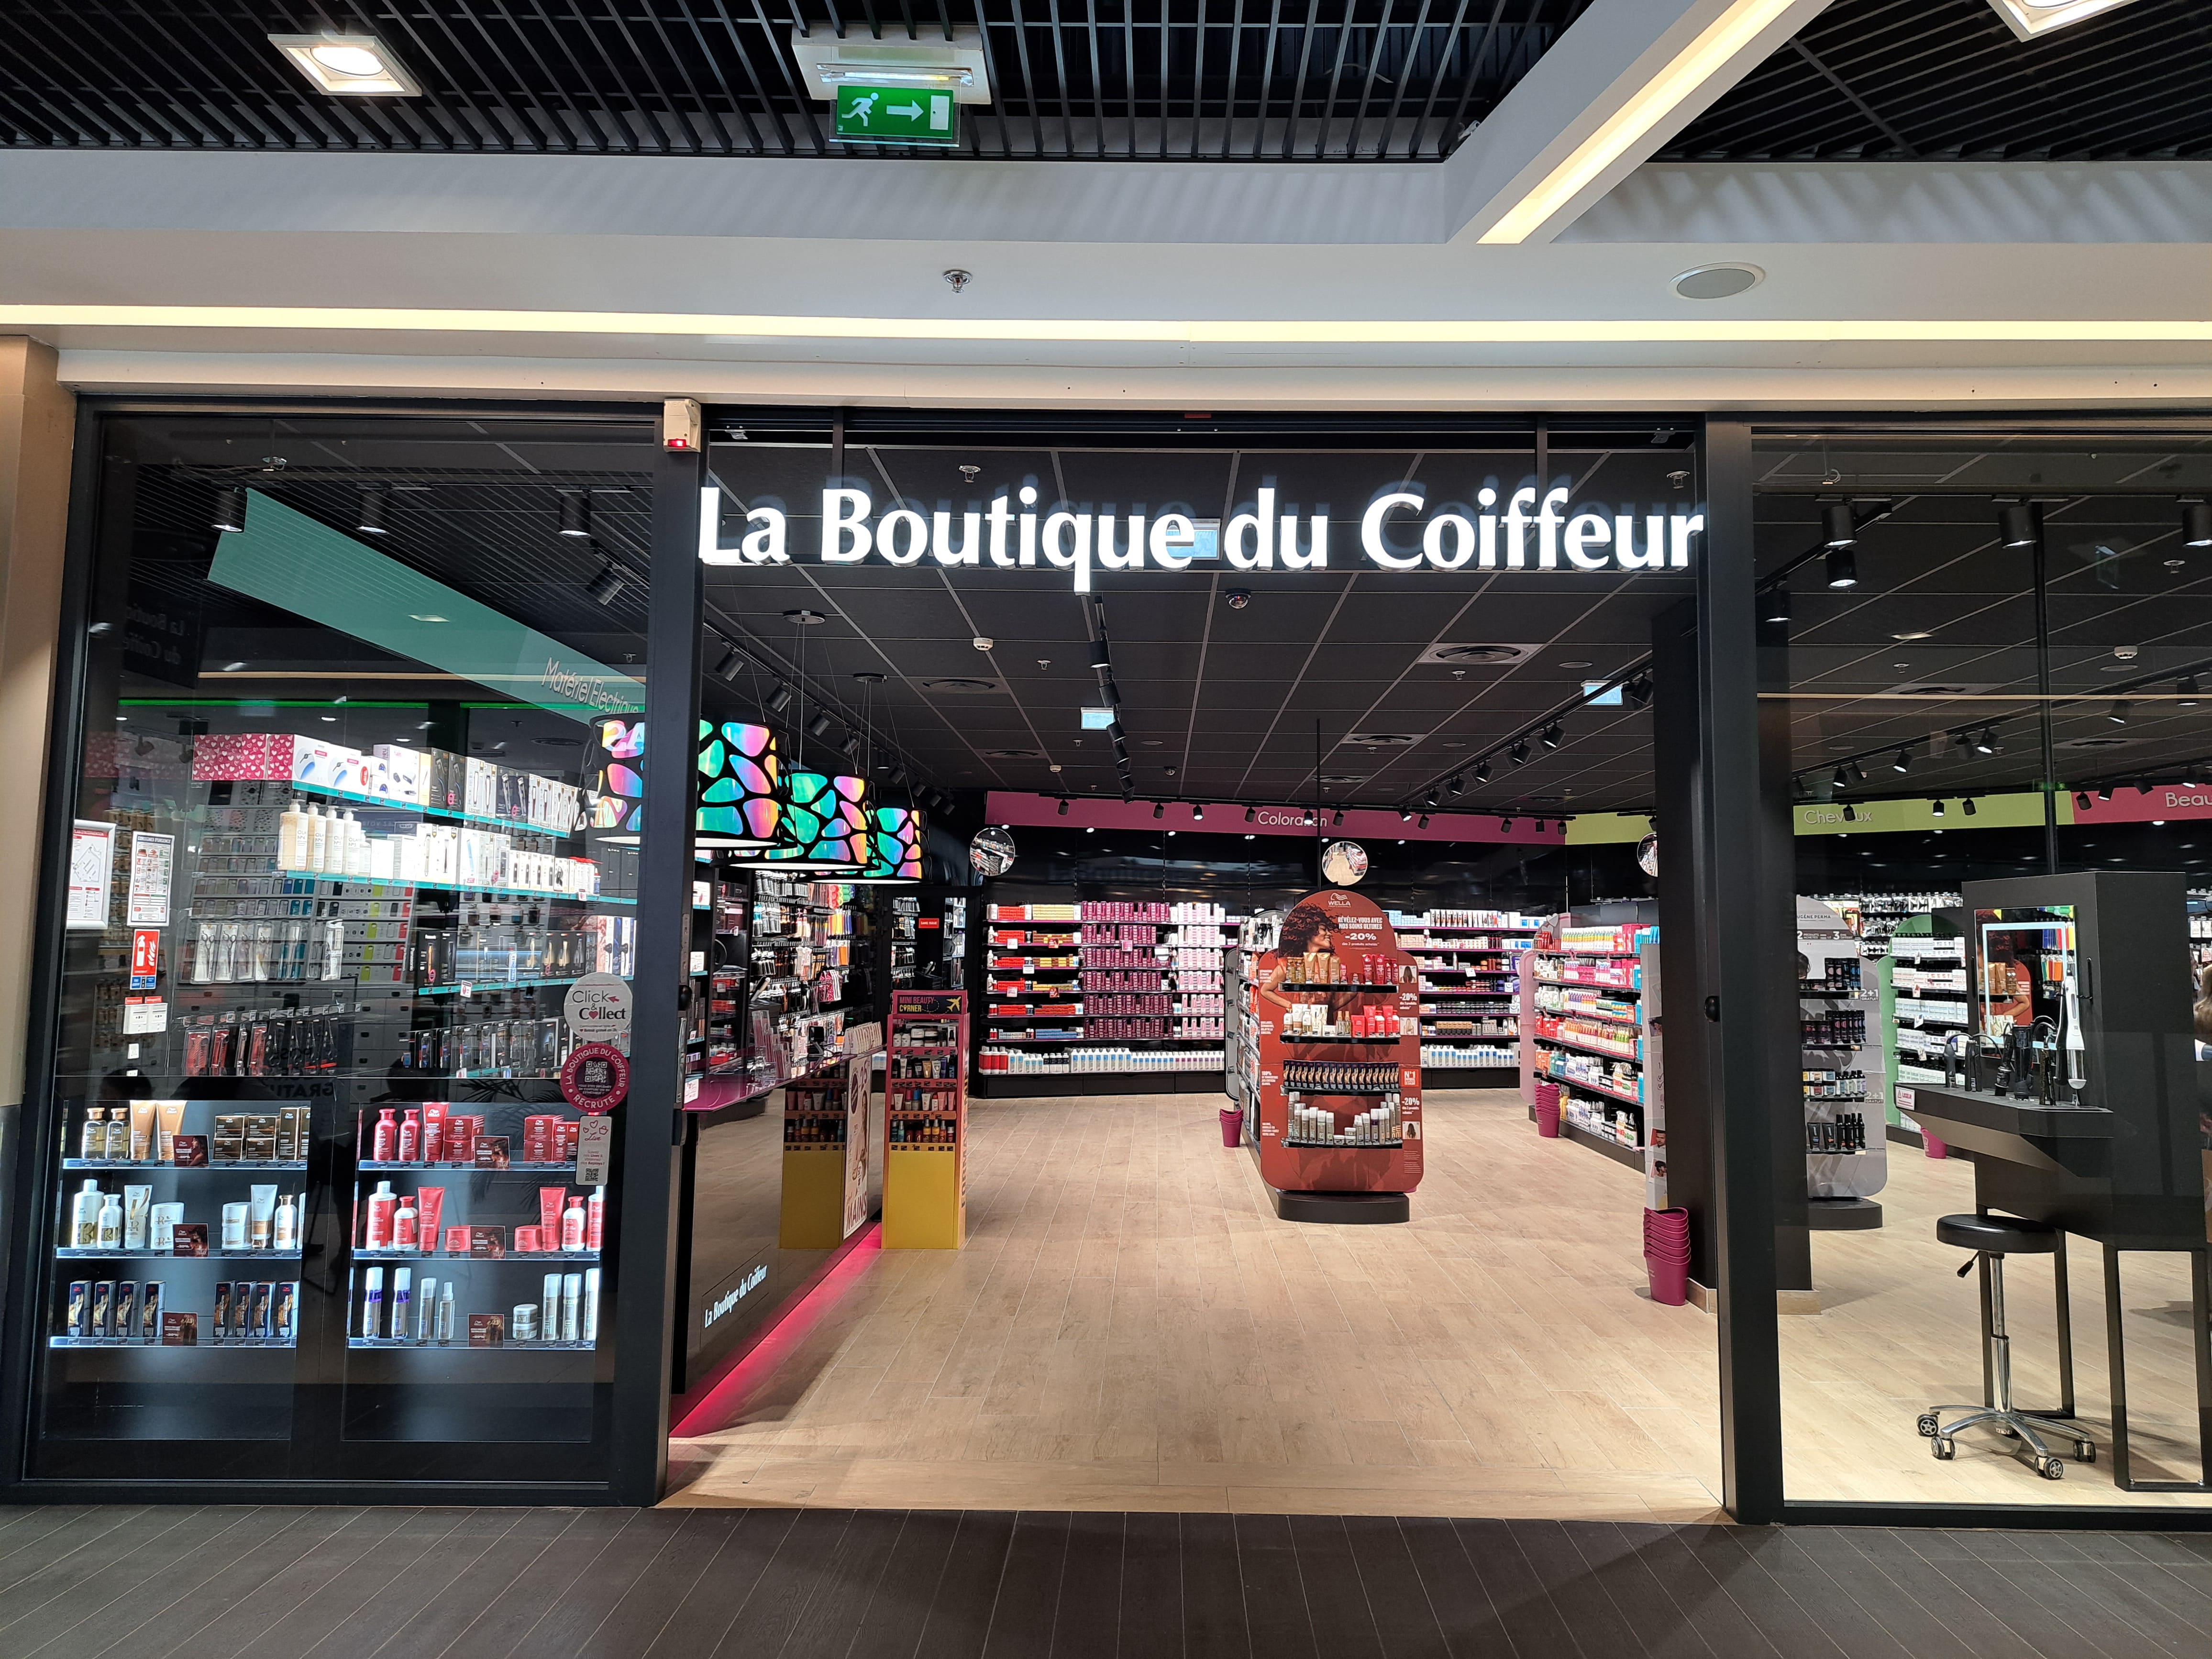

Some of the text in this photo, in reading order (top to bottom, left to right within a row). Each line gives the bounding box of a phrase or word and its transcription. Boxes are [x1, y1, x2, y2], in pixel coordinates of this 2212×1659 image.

[698, 486, 1704, 594] La Boutique du Coiffeur
[542, 657, 594, 704] Matériel
[1258, 811, 1327, 827] Coloraon
[1804, 810, 1872, 825] Chevux
[1345, 933, 1377, 941] -20%
[1797, 931, 1803, 940] 2
[1833, 931, 1840, 940] 3
[572, 990, 609, 1003] Click
[1399, 993, 1417, 1001] -20%
[1860, 988, 1879, 997] 2+1
[565, 1048, 626, 1087] LA BOUTIQUE DU COIFFEUR
[1866, 1091, 1884, 1100] 2+1
[573, 1094, 615, 1109] RECRUTE
[1402, 1097, 1420, 1106] -20%
[584, 1132, 601, 1141] Live
[705, 1264, 767, 1328] La Boutique du Coiffeur
